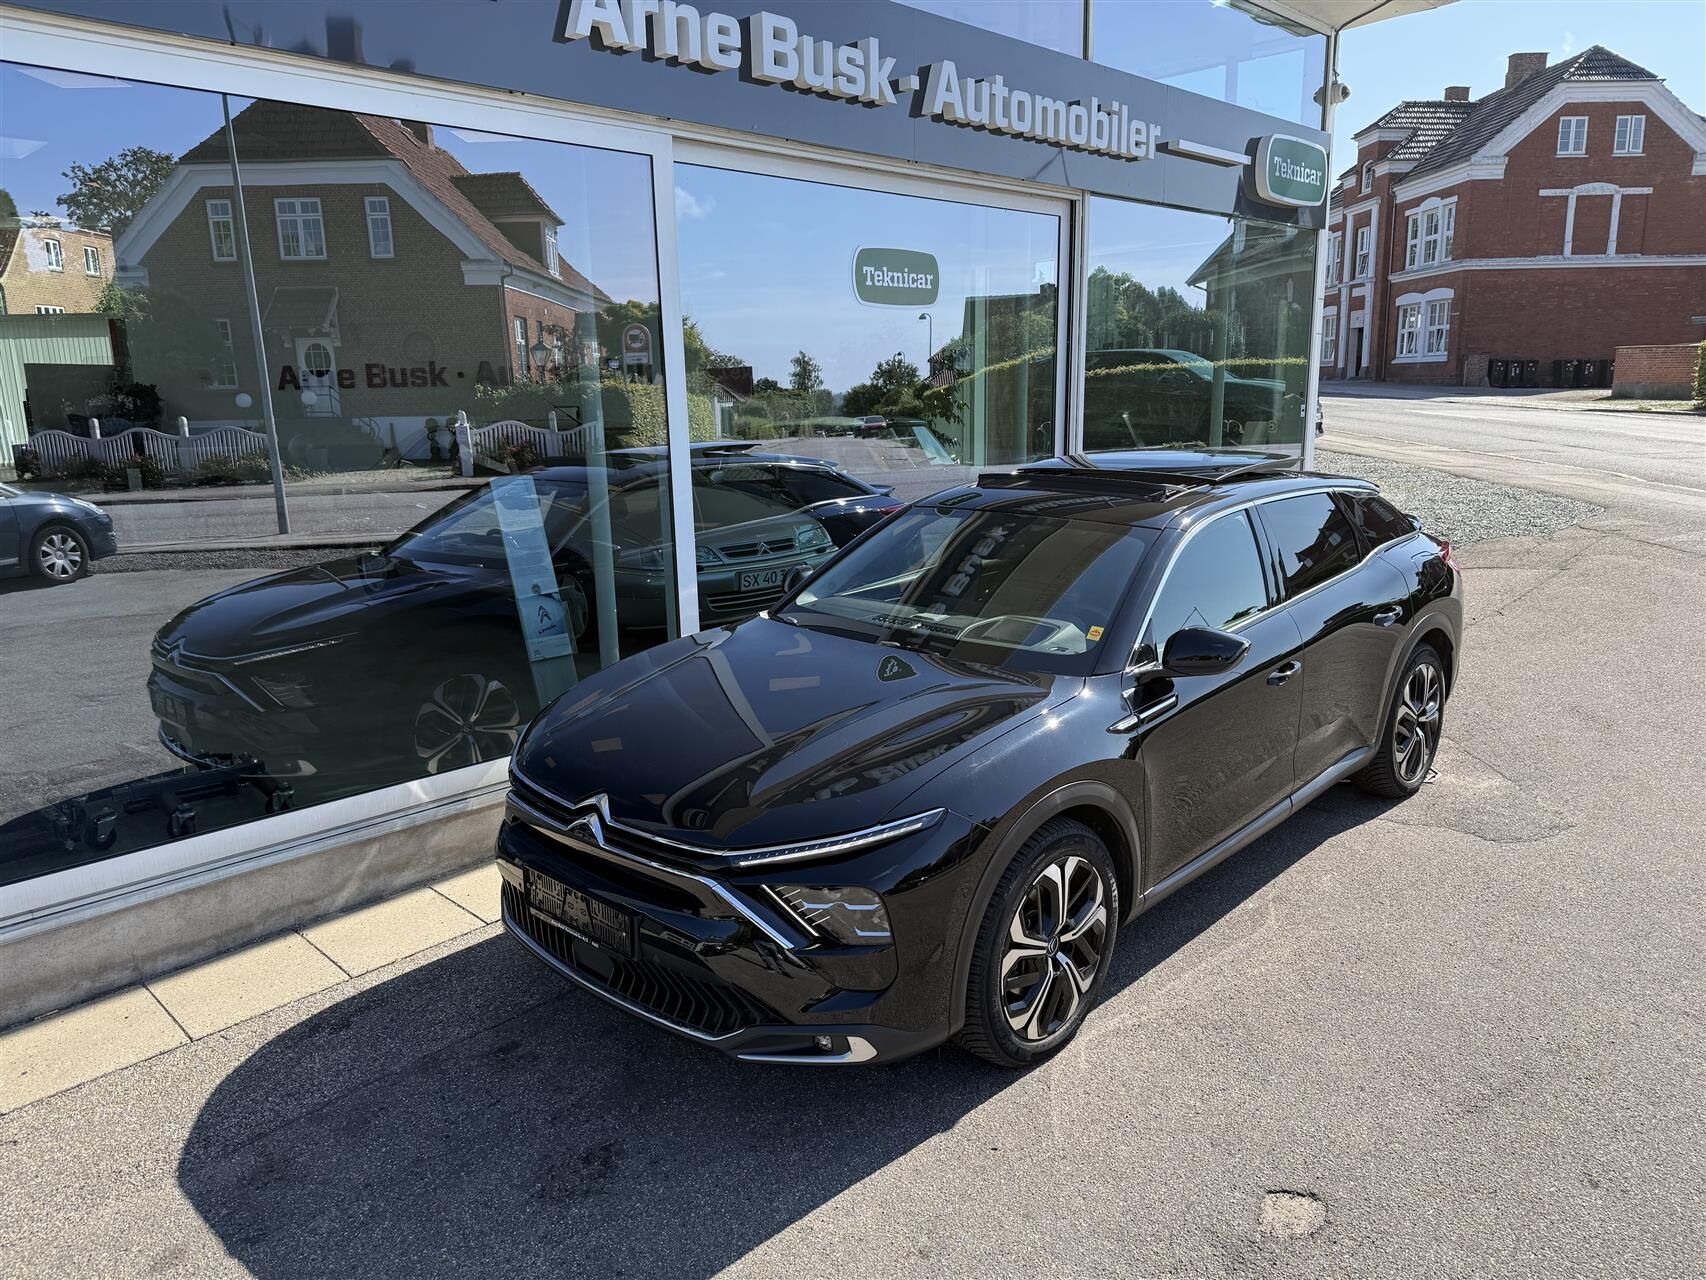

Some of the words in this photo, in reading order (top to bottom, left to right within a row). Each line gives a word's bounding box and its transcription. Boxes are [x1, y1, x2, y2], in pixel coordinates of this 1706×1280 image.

[564, 0, 742, 71] Arne
[751, 11, 898, 106] Busk
[922, 59, 1161, 160] Automobiler
[1273, 155, 1322, 186] Teknicar
[862, 265, 934, 289] Teknicar
[364, 360, 450, 388] Busk
[743, 573, 760, 588] SX
[762, 570, 778, 584] 40
